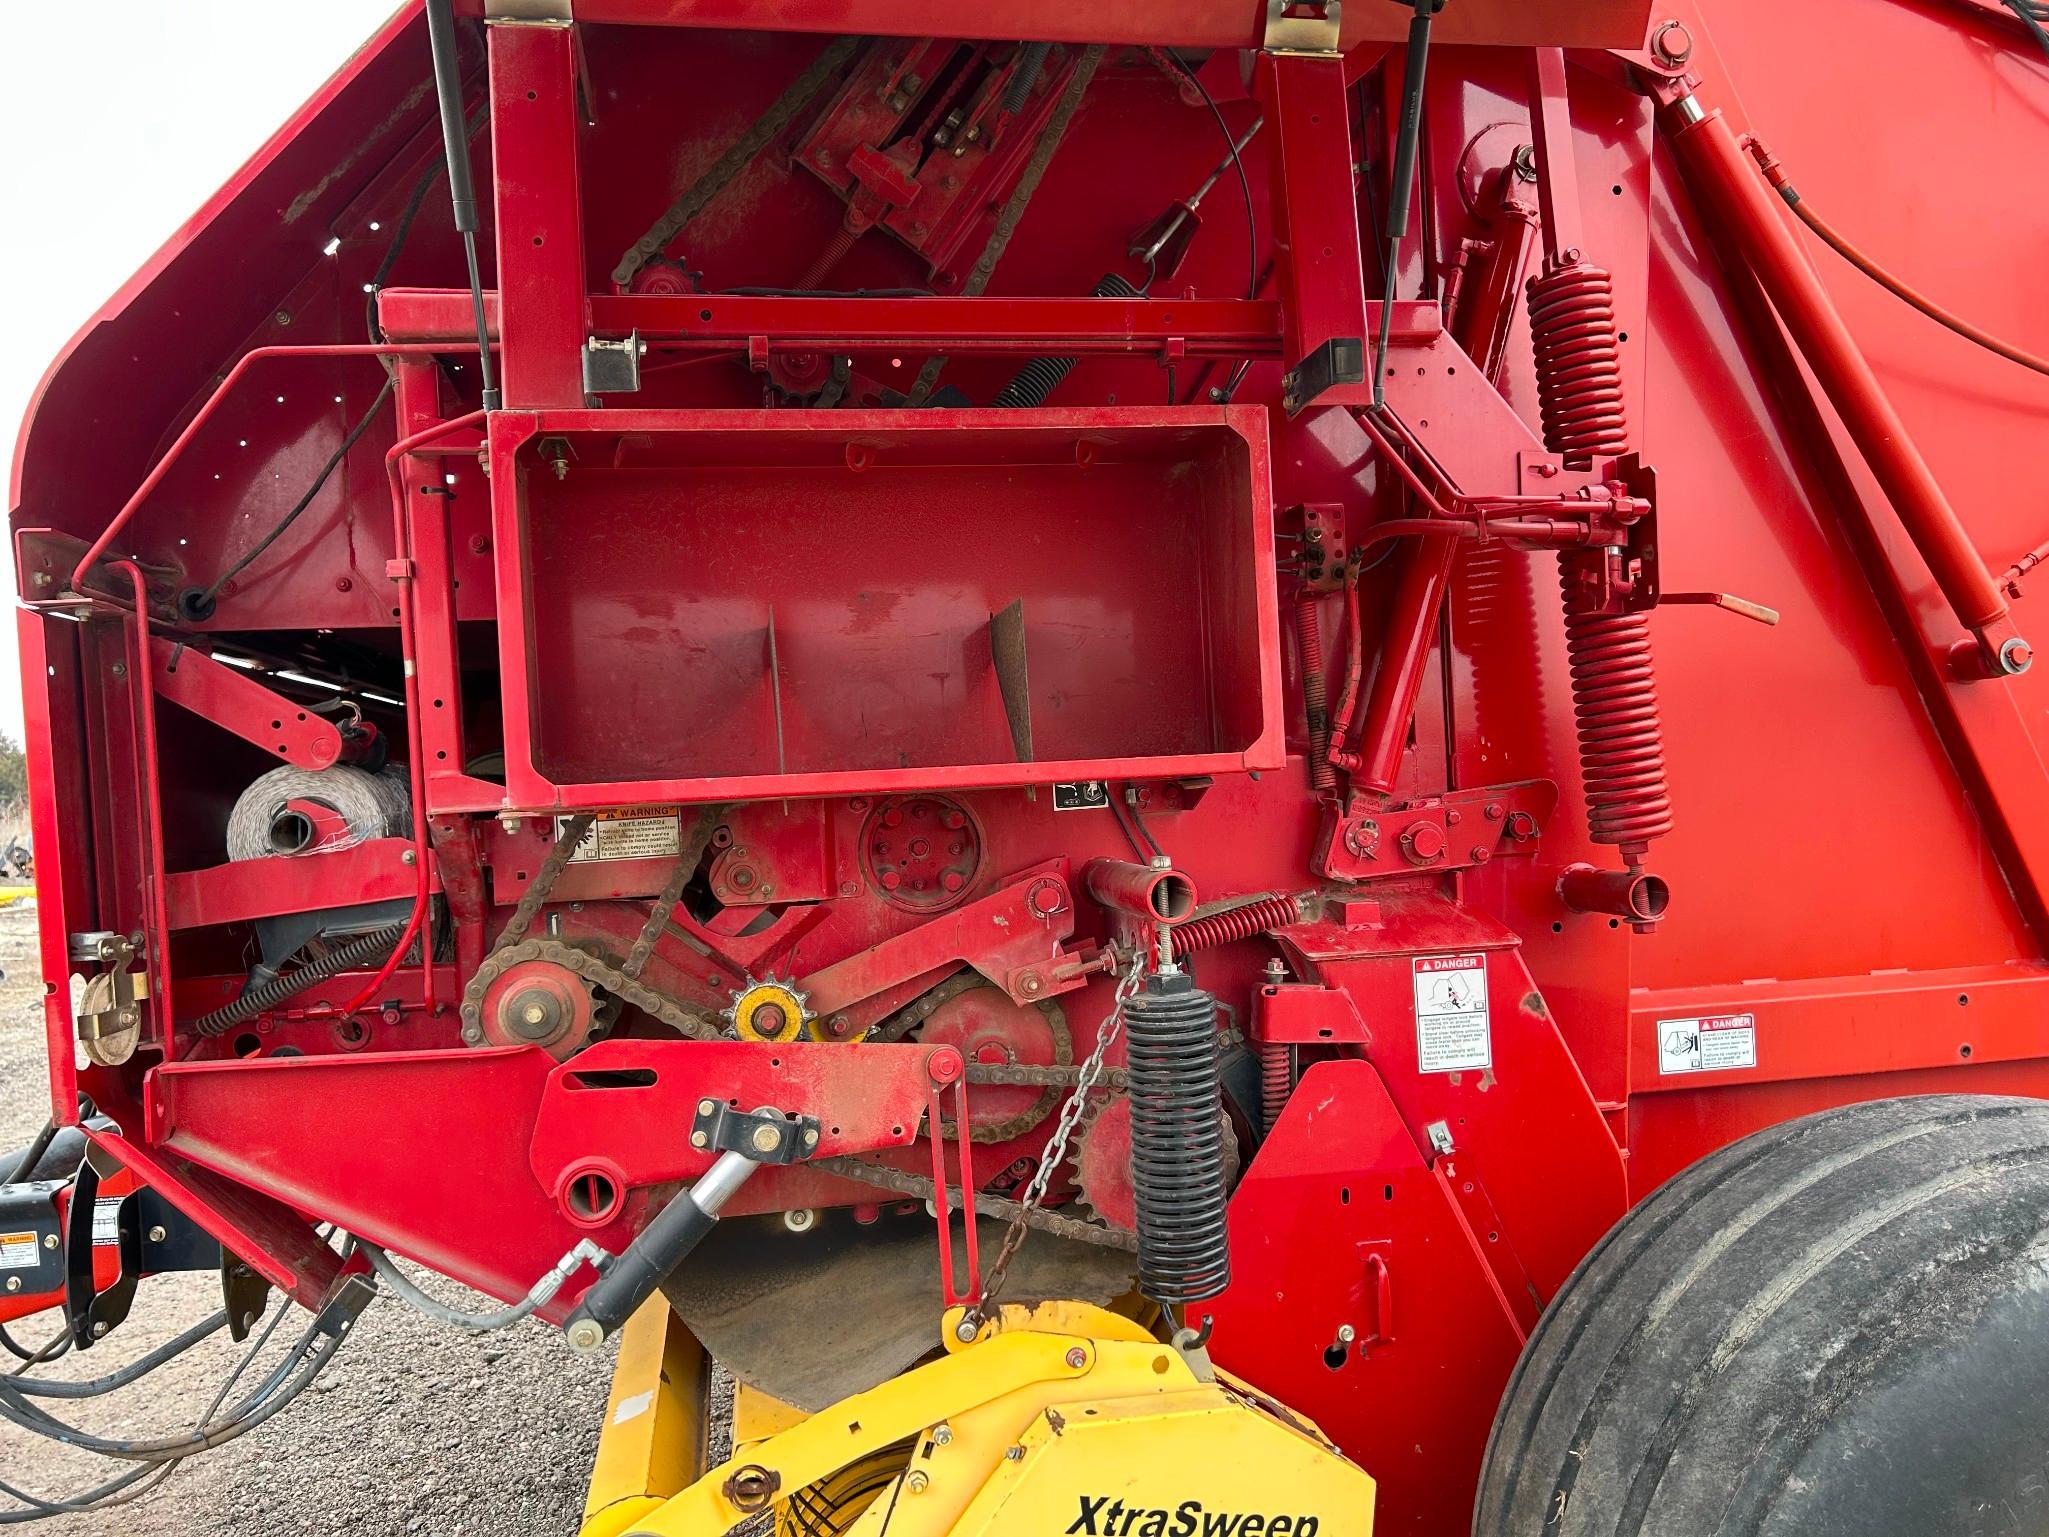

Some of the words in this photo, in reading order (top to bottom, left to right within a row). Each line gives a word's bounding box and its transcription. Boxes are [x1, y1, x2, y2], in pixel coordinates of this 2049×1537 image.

[620, 807, 668, 817] WARNING
[1434, 959, 1477, 969] DANGER
[1713, 1017, 1750, 1028] DANGER
[1065, 1495, 1320, 1537] XtraSweep
